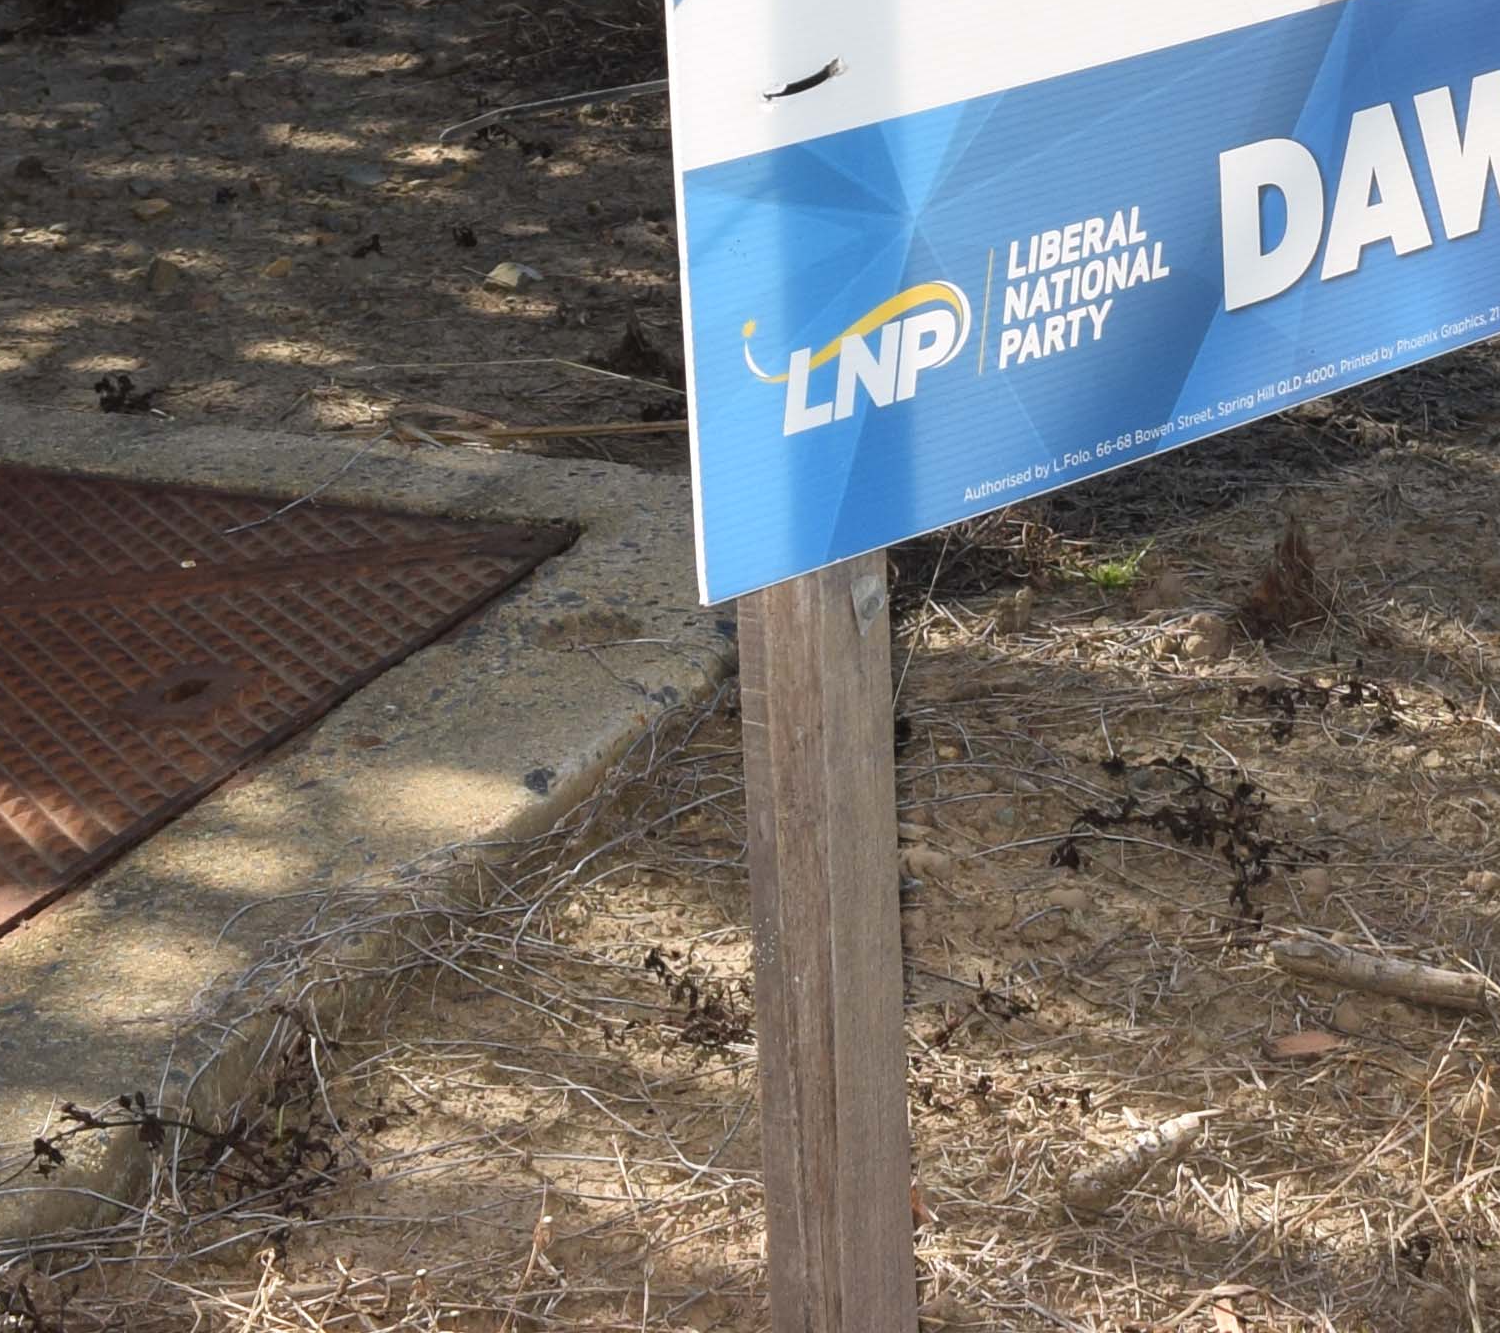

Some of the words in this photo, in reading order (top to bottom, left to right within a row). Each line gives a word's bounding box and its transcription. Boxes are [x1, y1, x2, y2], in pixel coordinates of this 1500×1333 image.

[1002, 242, 1170, 325] NATIONAL
[1007, 205, 1147, 280] LIBERAL
[783, 308, 957, 437] LNP
[998, 299, 1114, 369] PARTY
[963, 467, 1032, 503] Authorised
[1035, 462, 1051, 479] by
[1096, 433, 1132, 458] 66-68
[1135, 421, 1174, 445] Bowen
[1218, 393, 1254, 417] Spring
[1257, 384, 1275, 402] Hill
[1277, 376, 1301, 395] QLD
[1340, 351, 1379, 374] Printed
[1382, 346, 1394, 361] by
[1397, 332, 1438, 354] Phoenix
[1489, 306, 1500, 322] 21
